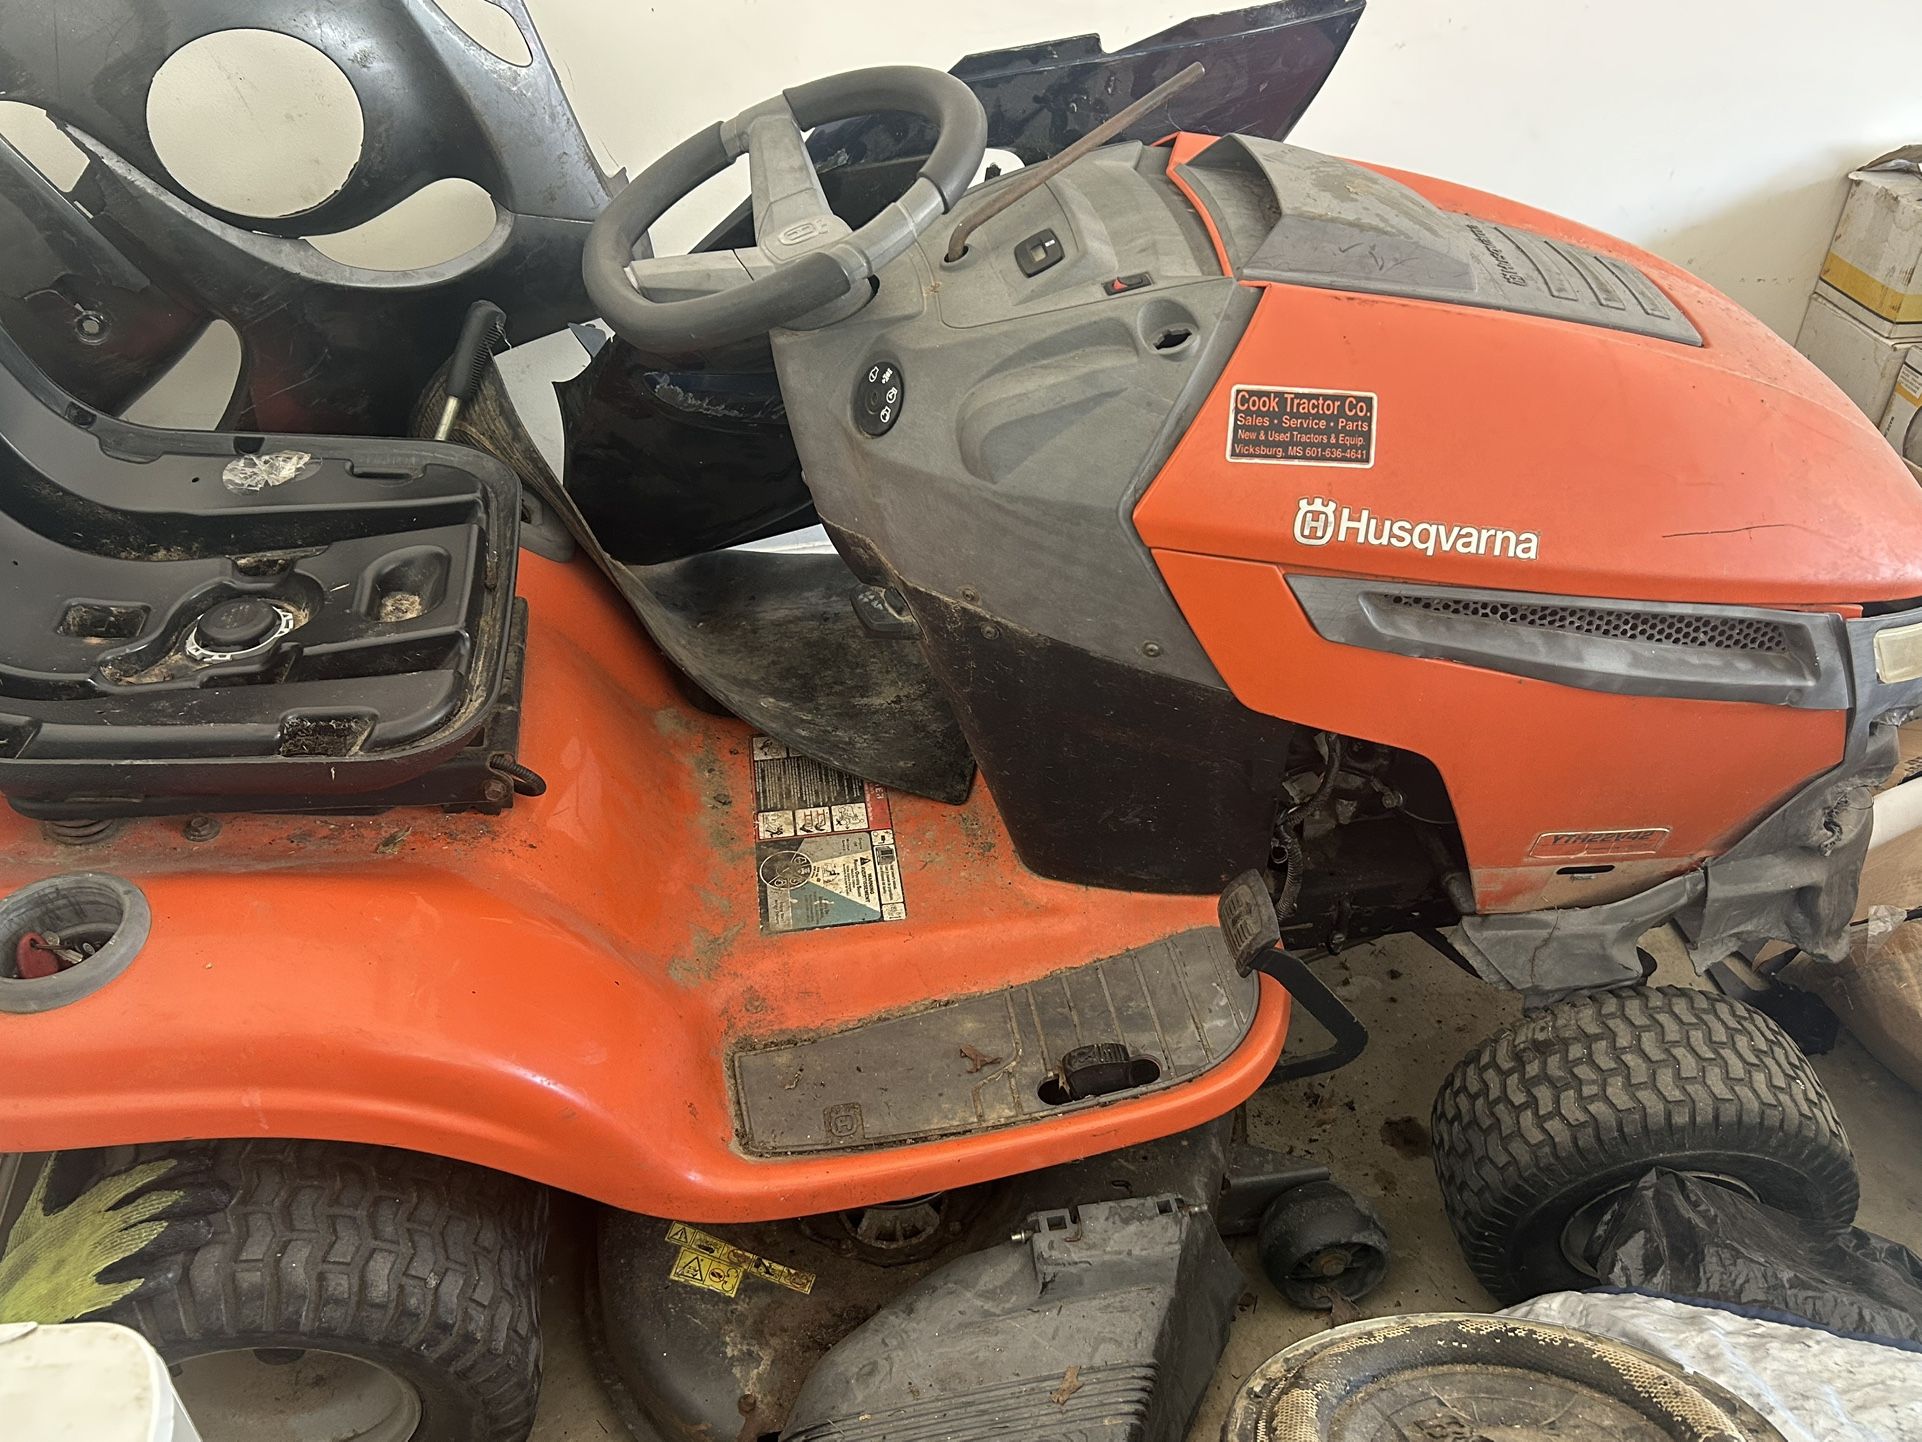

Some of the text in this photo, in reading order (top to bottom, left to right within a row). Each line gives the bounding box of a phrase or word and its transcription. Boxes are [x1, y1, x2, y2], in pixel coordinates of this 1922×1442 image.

[1237, 391, 1370, 416] Cook Tractor Co.
[1237, 414, 1369, 431] Sales Service Parts
[1237, 430, 1365, 447] New & Used Tractors & Equip.
[1234, 444, 1367, 459] Vicksburg, MS 601-636-4641
[1337, 507, 1538, 560] Husqvarna
